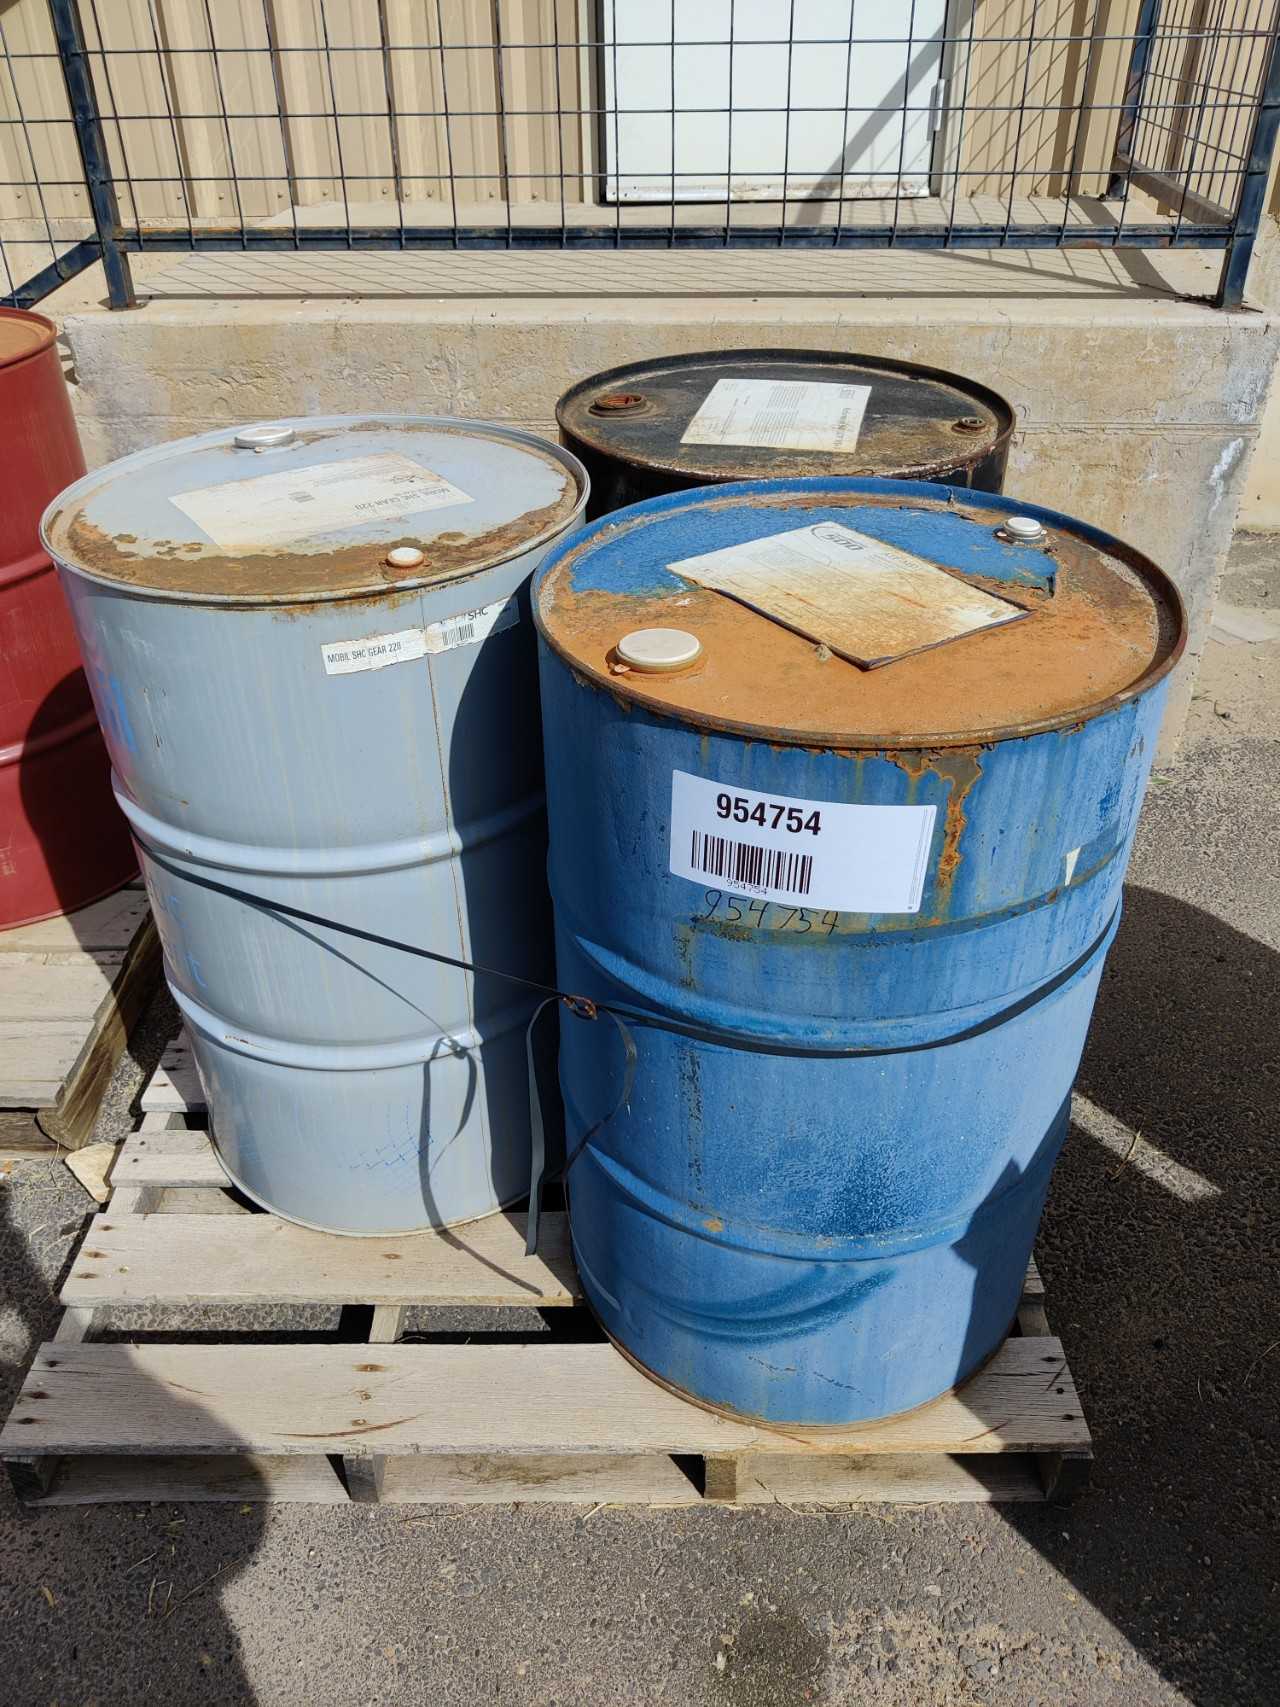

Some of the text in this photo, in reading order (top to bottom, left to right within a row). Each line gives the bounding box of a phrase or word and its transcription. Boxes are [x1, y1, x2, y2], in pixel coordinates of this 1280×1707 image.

[467, 606, 488, 621] SHC
[328, 650, 350, 663] MOBIL
[352, 647, 366, 660] SHC
[368, 643, 387, 657] GEAR
[716, 793, 821, 836] 954754
[726, 878, 768, 895] 954754
[704, 889, 840, 936] 954754
